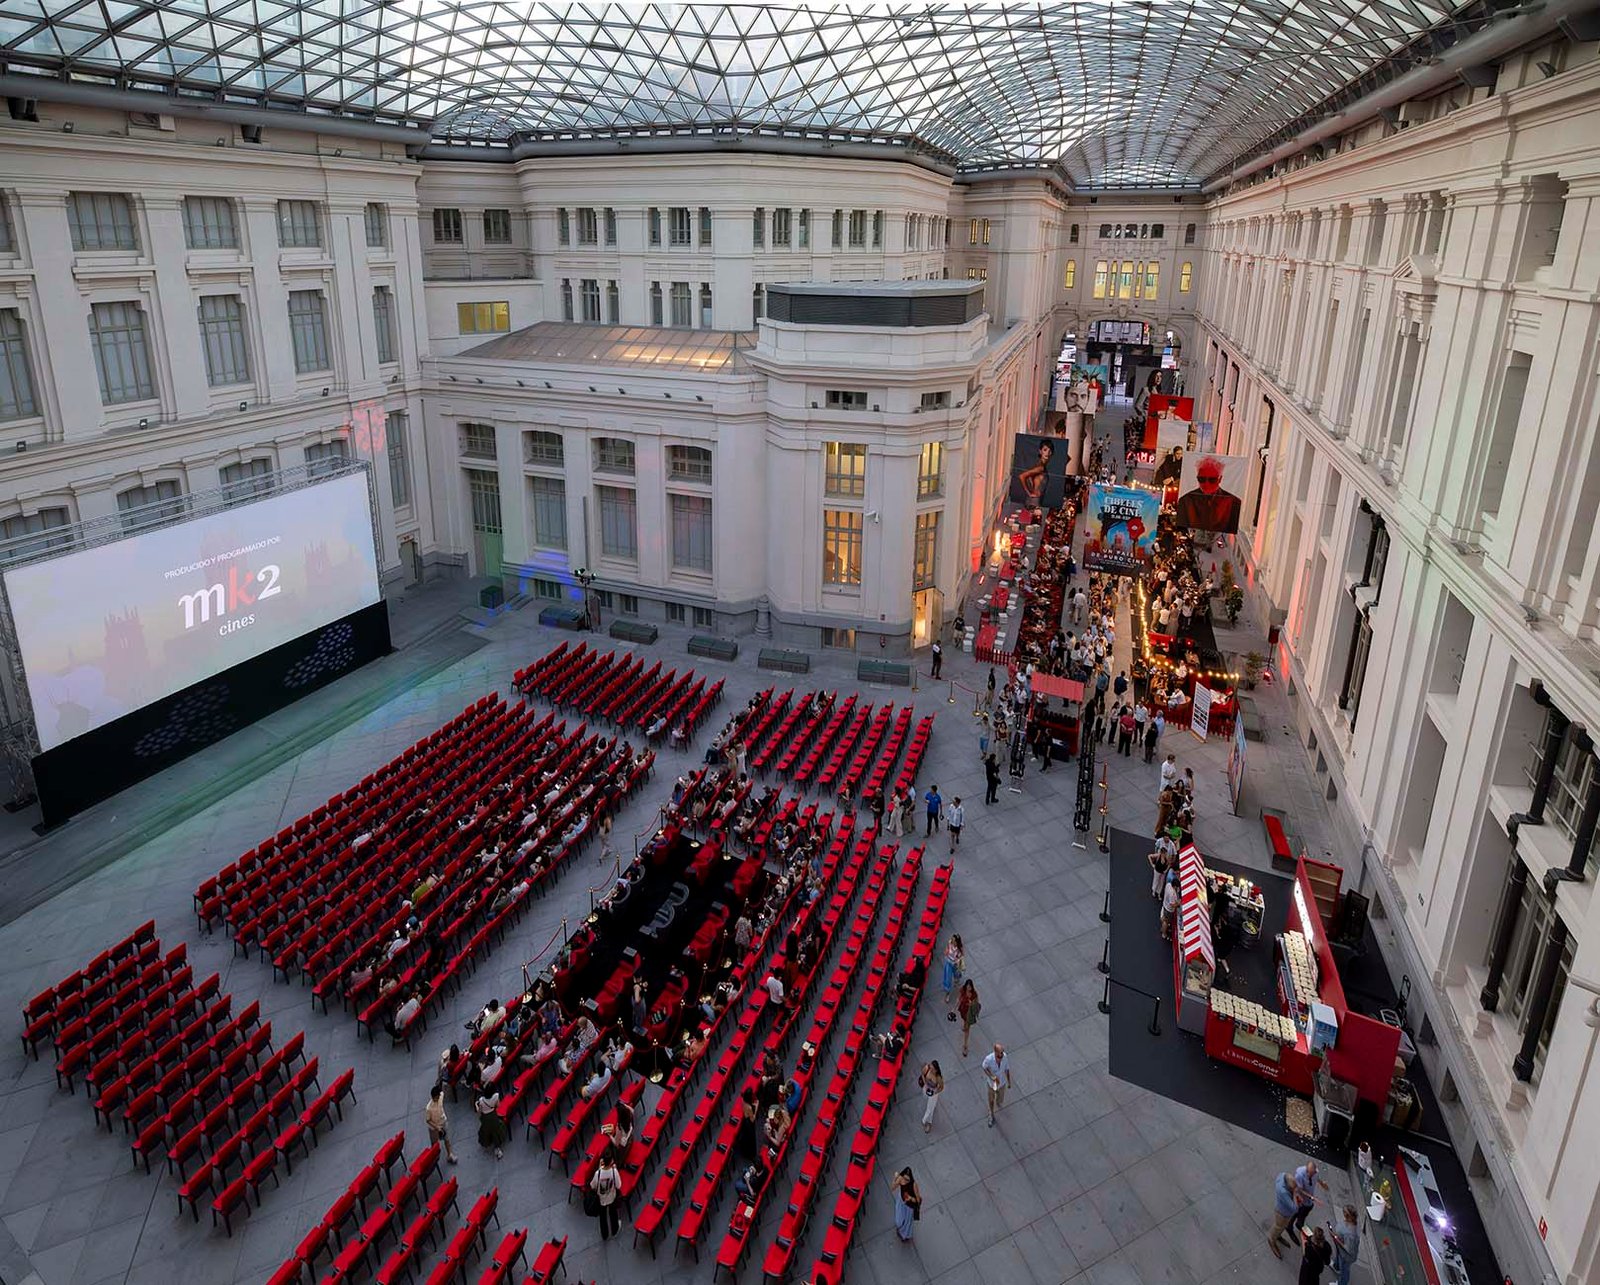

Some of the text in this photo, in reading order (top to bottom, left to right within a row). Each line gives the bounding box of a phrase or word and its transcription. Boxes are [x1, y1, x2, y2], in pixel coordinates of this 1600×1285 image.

[1104, 504, 1118, 515] DE
[164, 561, 211, 579] PRODUCIDO
[217, 540, 266, 562] PROGRAMADO
[178, 564, 281, 629] mk2
[219, 613, 256, 636] cines
